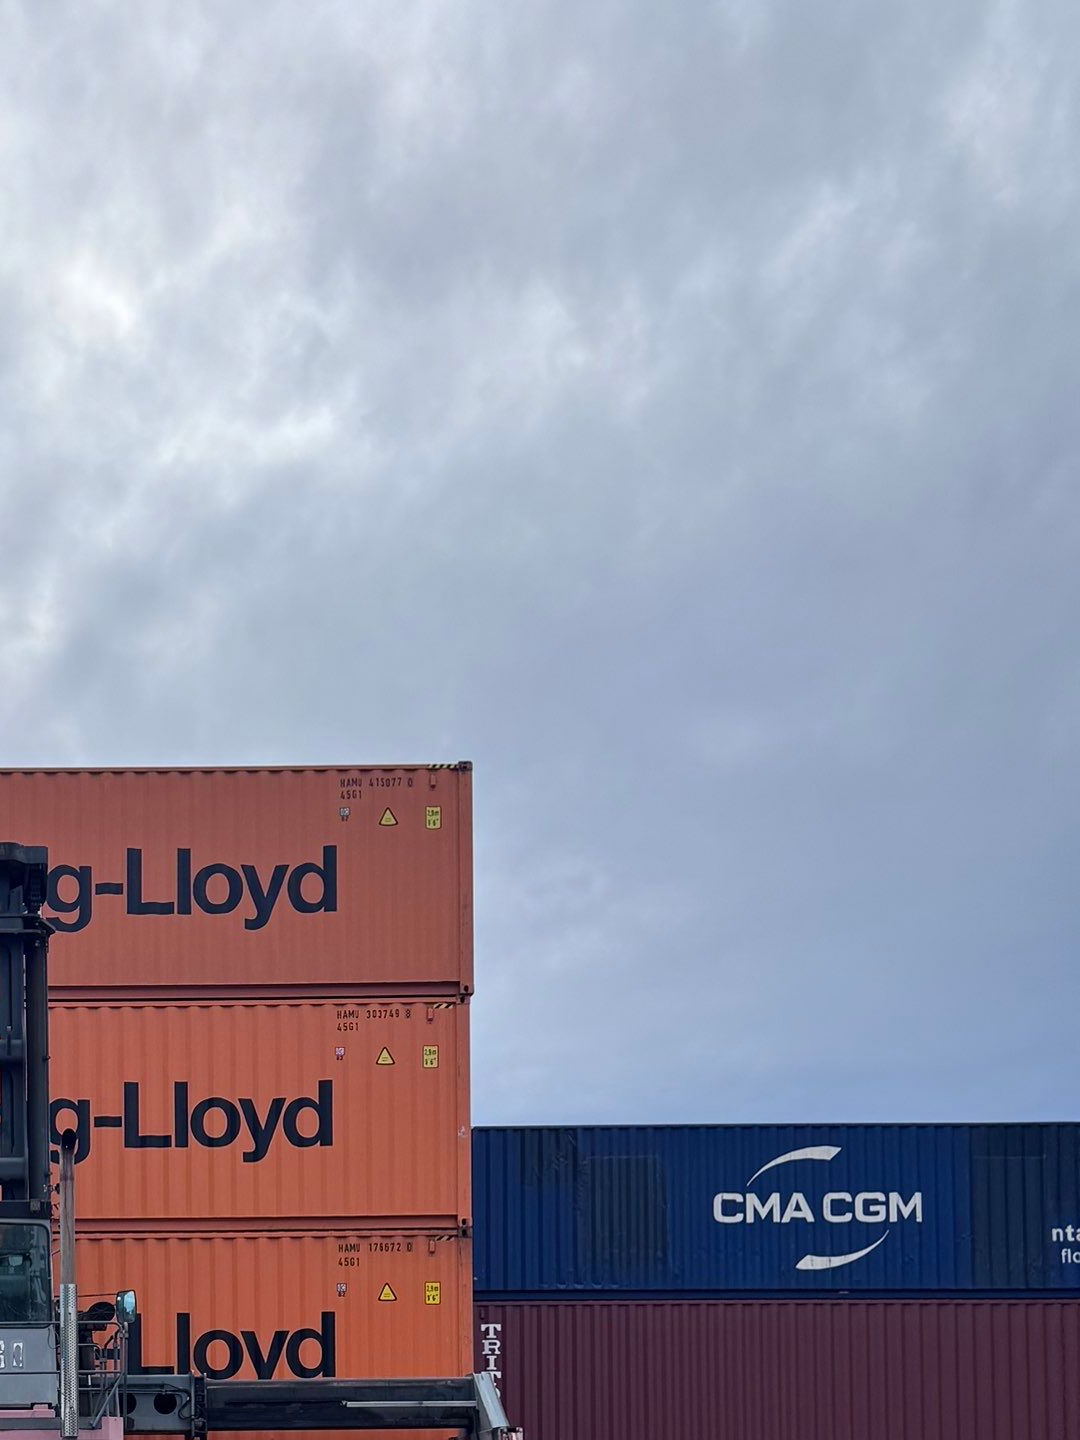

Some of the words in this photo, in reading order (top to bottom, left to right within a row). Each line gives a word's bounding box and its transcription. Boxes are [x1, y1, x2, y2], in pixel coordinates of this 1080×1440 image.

[340, 778, 362, 787] HAMU
[340, 789, 362, 799] 45G1
[336, 1010, 359, 1019] HAMU
[366, 1009, 400, 1019] 303749
[336, 1022, 359, 1032] 45G1
[713, 1192, 815, 1224] CMA
[822, 1191, 923, 1224] CGM
[338, 1243, 360, 1253] HAMU
[338, 1257, 360, 1267] 45G1
